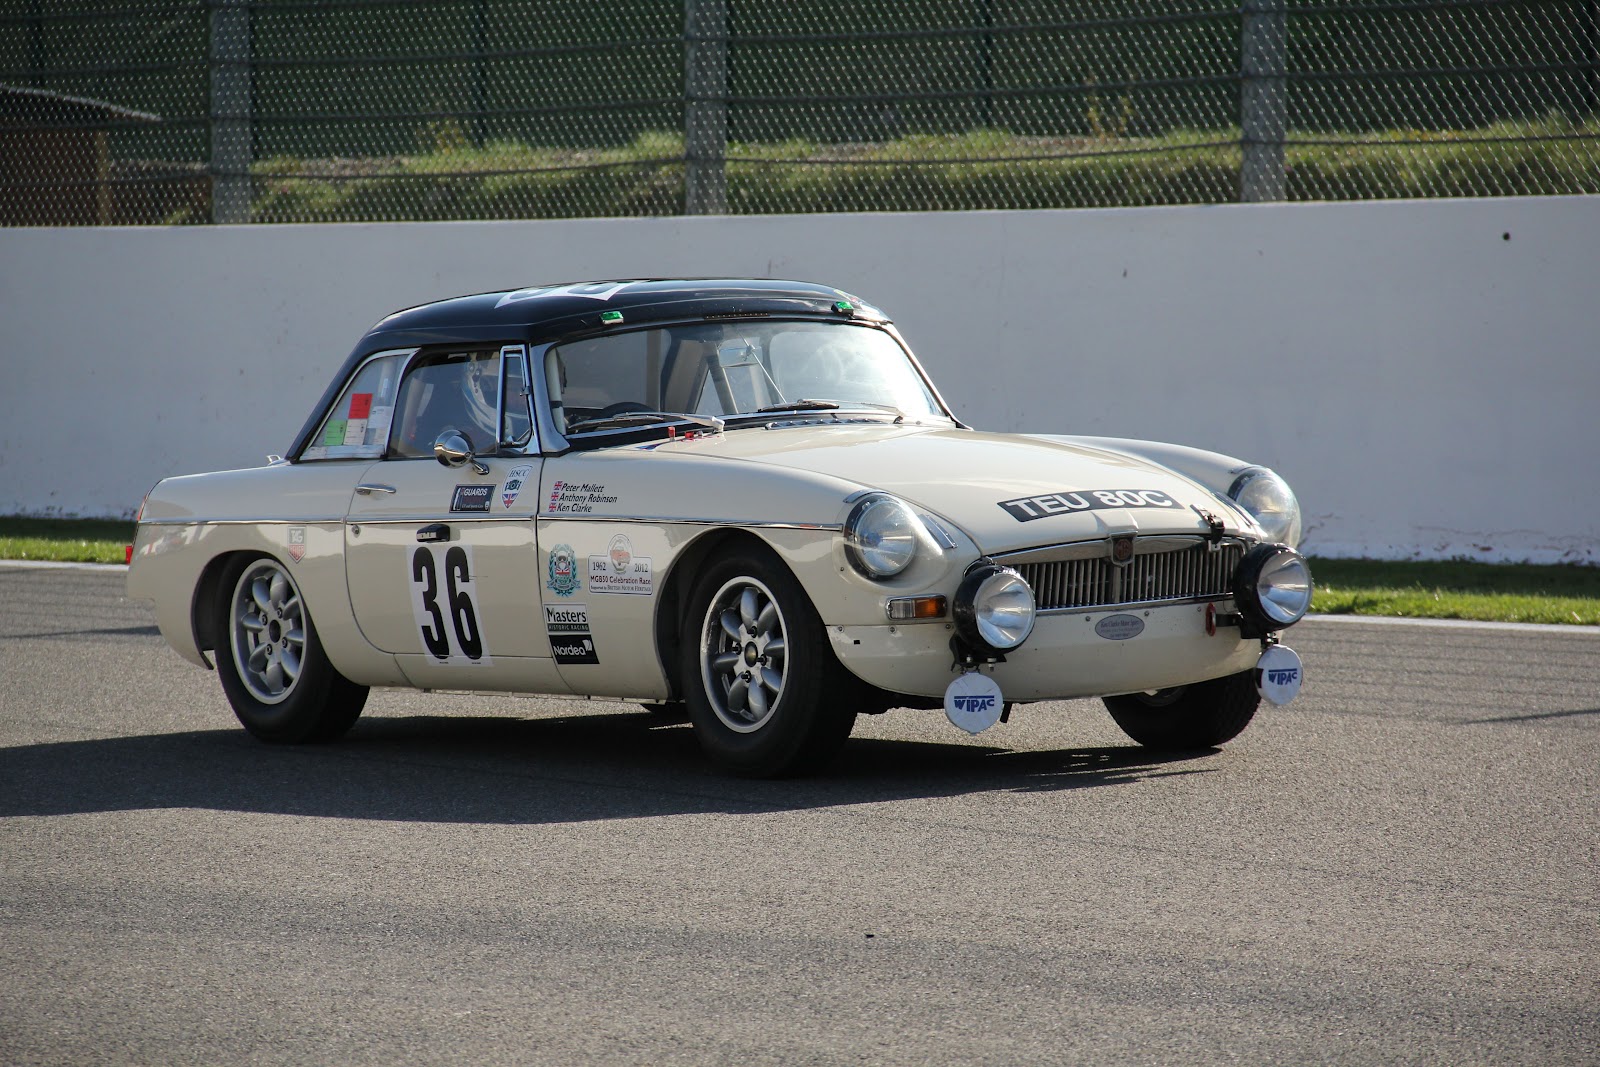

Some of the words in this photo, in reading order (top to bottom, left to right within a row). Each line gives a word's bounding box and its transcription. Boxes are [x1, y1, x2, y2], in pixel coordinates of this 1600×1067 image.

[463, 487, 488, 496] GUARDS
[560, 483, 580, 492] Peter
[580, 483, 605, 493] Mallett
[558, 493, 587, 504] Anthony
[588, 493, 618, 503] Robinson
[1007, 493, 1090, 517] TEU
[1093, 490, 1173, 507] 80C
[556, 503, 570, 512] Ken
[571, 503, 592, 513] Clarke
[592, 562, 607, 571] 1962
[634, 563, 649, 573] 2012
[590, 575, 609, 583] MGB50
[609, 576, 638, 584] Celebration
[639, 577, 651, 585] Race
[413, 546, 483, 660] 36
[546, 607, 587, 623] Masters
[552, 644, 587, 656] Nordea
[1268, 671, 1298, 686] WIPAC
[953, 698, 995, 713] WIPAC
